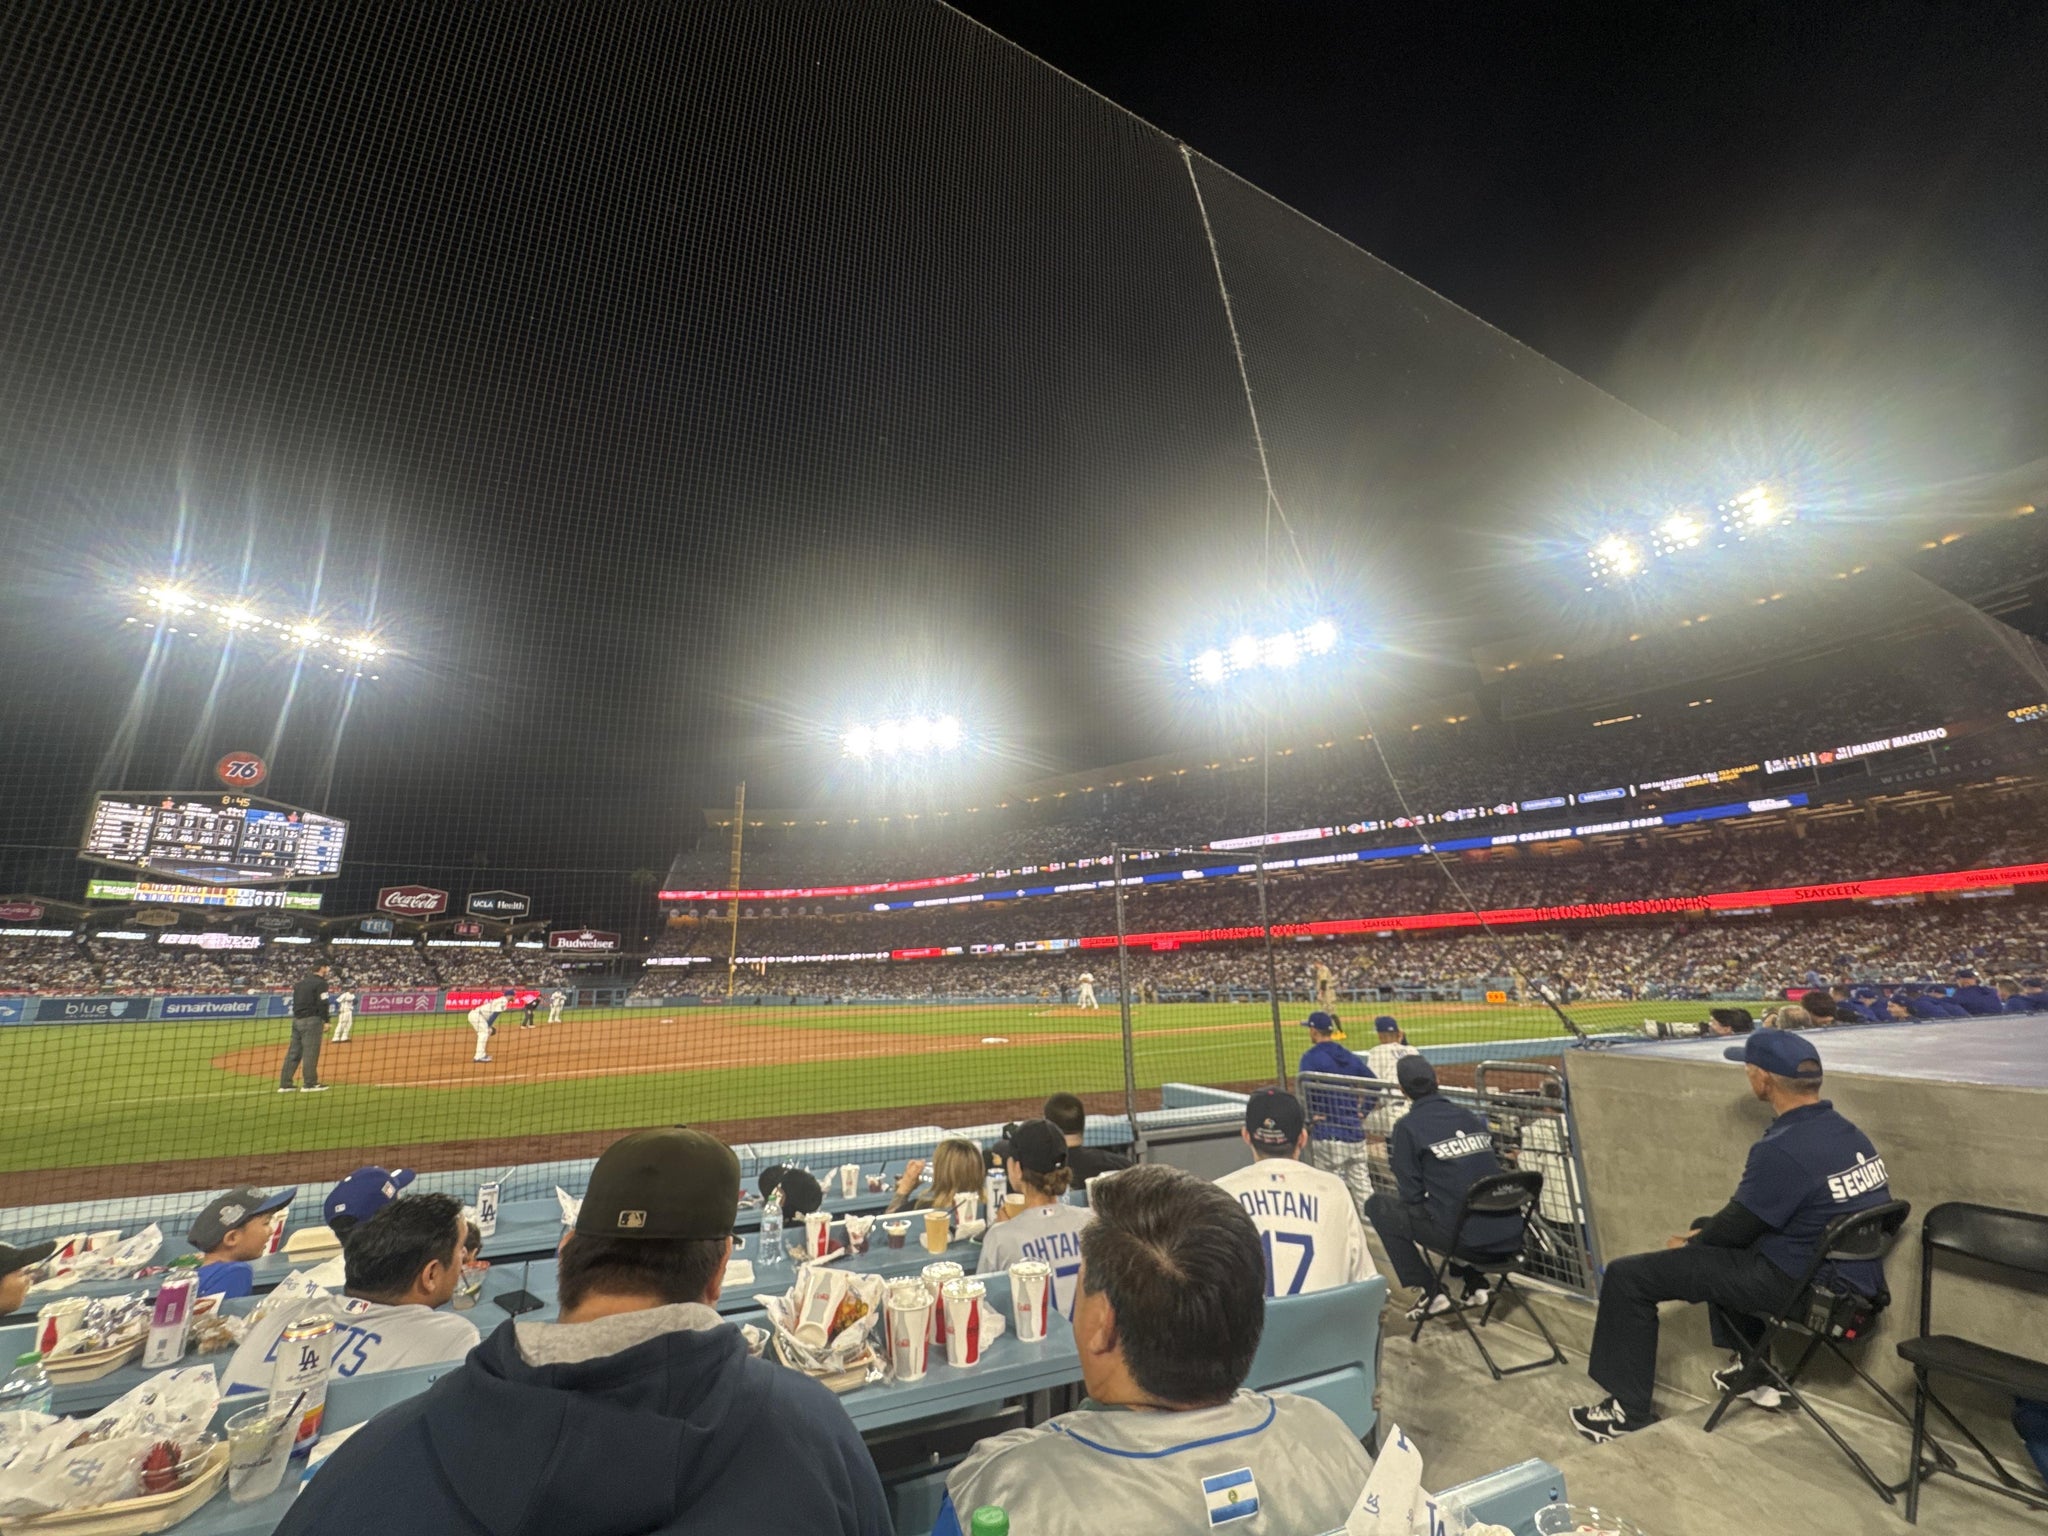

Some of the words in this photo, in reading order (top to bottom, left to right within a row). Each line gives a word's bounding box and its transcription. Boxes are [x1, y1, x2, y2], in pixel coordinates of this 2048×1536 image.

[1852, 739, 1892, 757] MANNY
[1892, 727, 1948, 749] MACHADO
[225, 760, 259, 780] 76
[1880, 762, 1962, 785] WELCOME
[1971, 758, 1993, 769] TO
[222, 795, 251, 808] 8:45
[1519, 828, 1572, 842] COASTER
[1576, 820, 1631, 835] SUMMER
[384, 890, 442, 909] Coca-Cola
[1795, 885, 1863, 900] SEATGEEK
[472, 900, 494, 909] UCLA
[497, 900, 525, 911] Health
[557, 937, 615, 949] Budweiser
[65, 1002, 109, 1015] blue
[166, 1001, 253, 1014] smartwater
[369, 996, 414, 1006] DAISO
[480, 1200, 496, 1222] LA
[1239, 1190, 1319, 1223] OHTANI
[299, 1345, 319, 1371] LA
